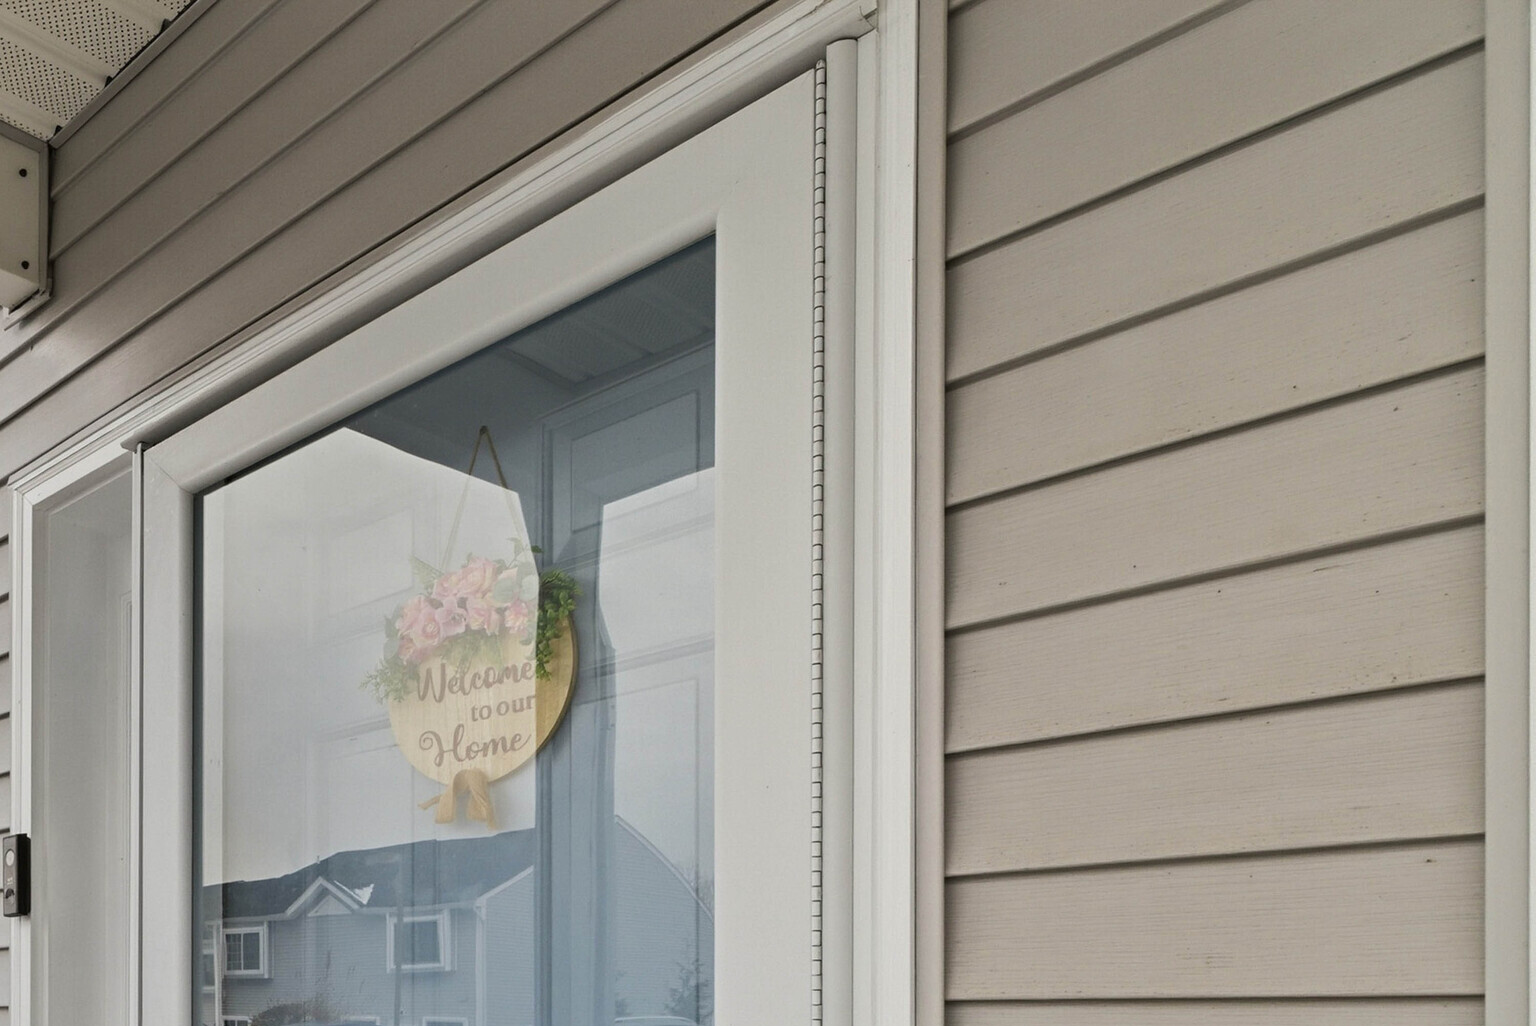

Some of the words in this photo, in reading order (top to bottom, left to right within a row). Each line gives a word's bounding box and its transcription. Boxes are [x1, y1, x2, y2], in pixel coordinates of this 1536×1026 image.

[418, 661, 535, 703] Welcome
[471, 705, 492, 721] to
[496, 695, 536, 716] our
[419, 724, 532, 767] Home
